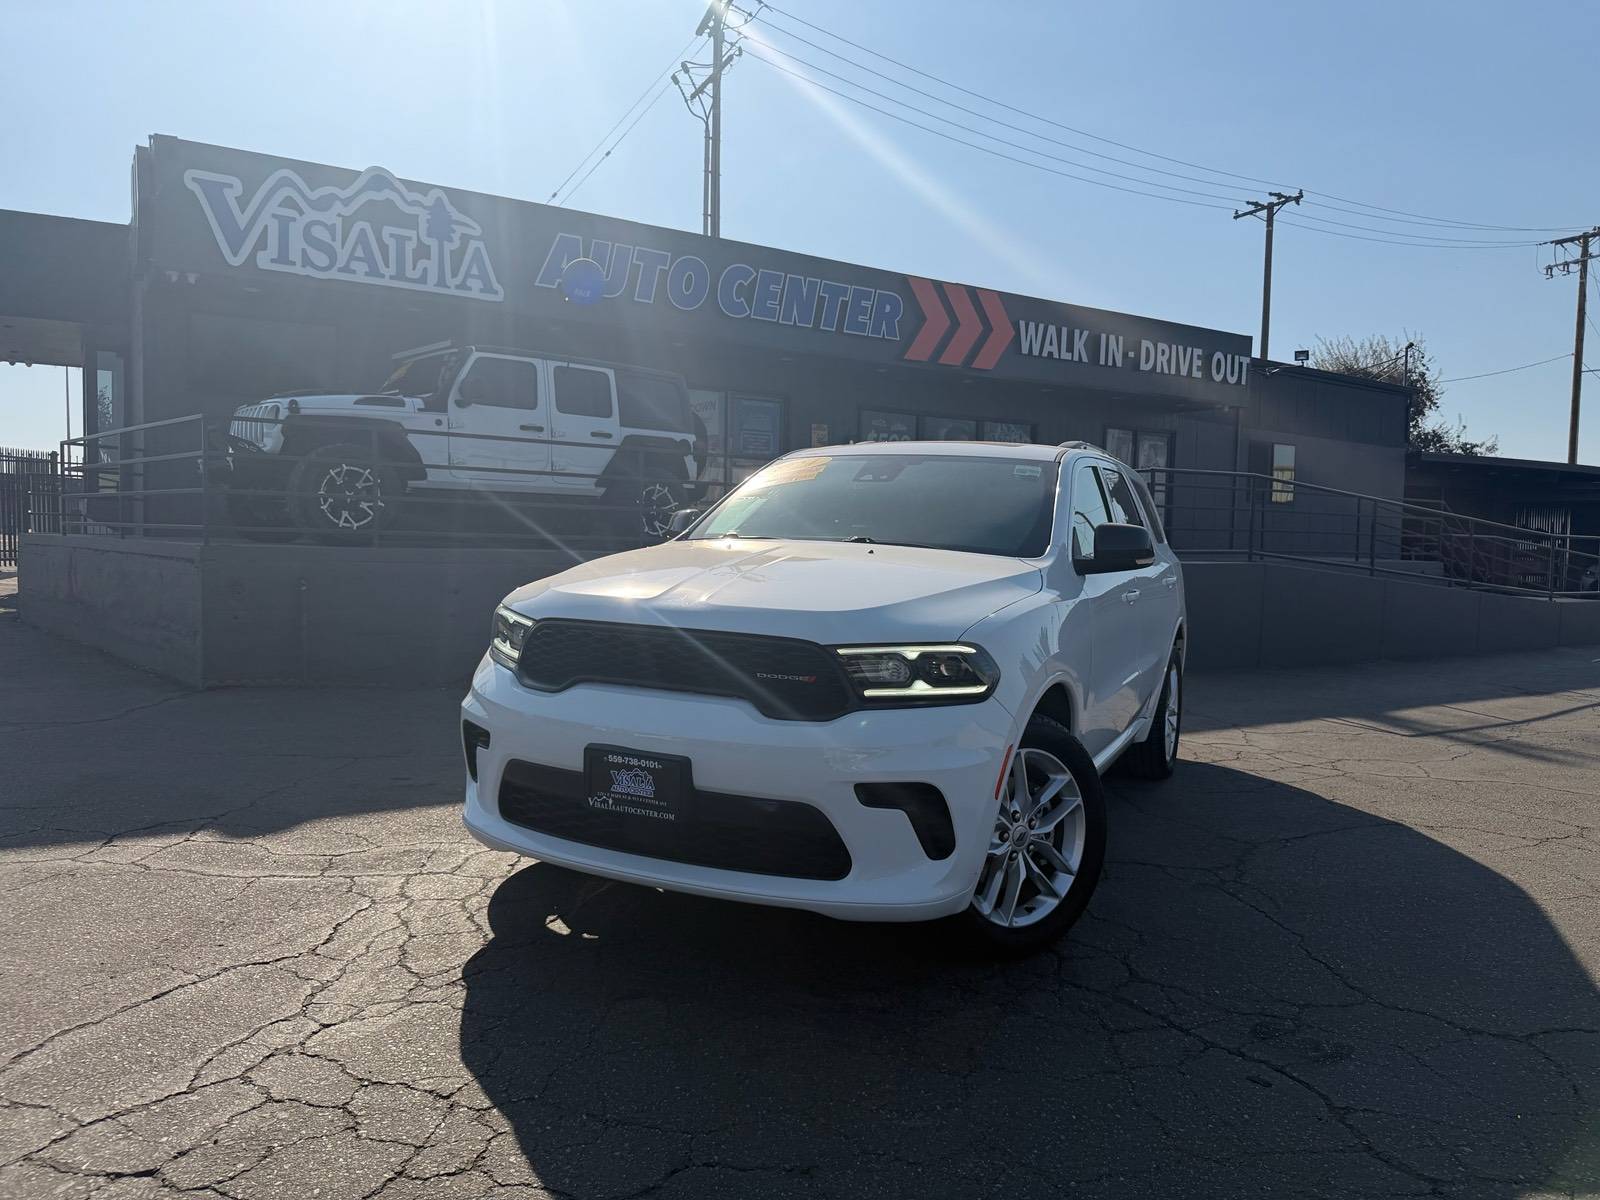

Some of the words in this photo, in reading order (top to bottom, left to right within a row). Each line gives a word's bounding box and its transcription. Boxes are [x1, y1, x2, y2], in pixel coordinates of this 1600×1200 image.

[185, 168, 503, 300] VISALIA
[534, 232, 710, 311] AUTO
[718, 263, 904, 340] CENTER
[1019, 320, 1089, 363] WALK
[1211, 351, 1250, 385] OUT
[756, 672, 808, 681] DODGE
[610, 768, 655, 790] VISALIA
